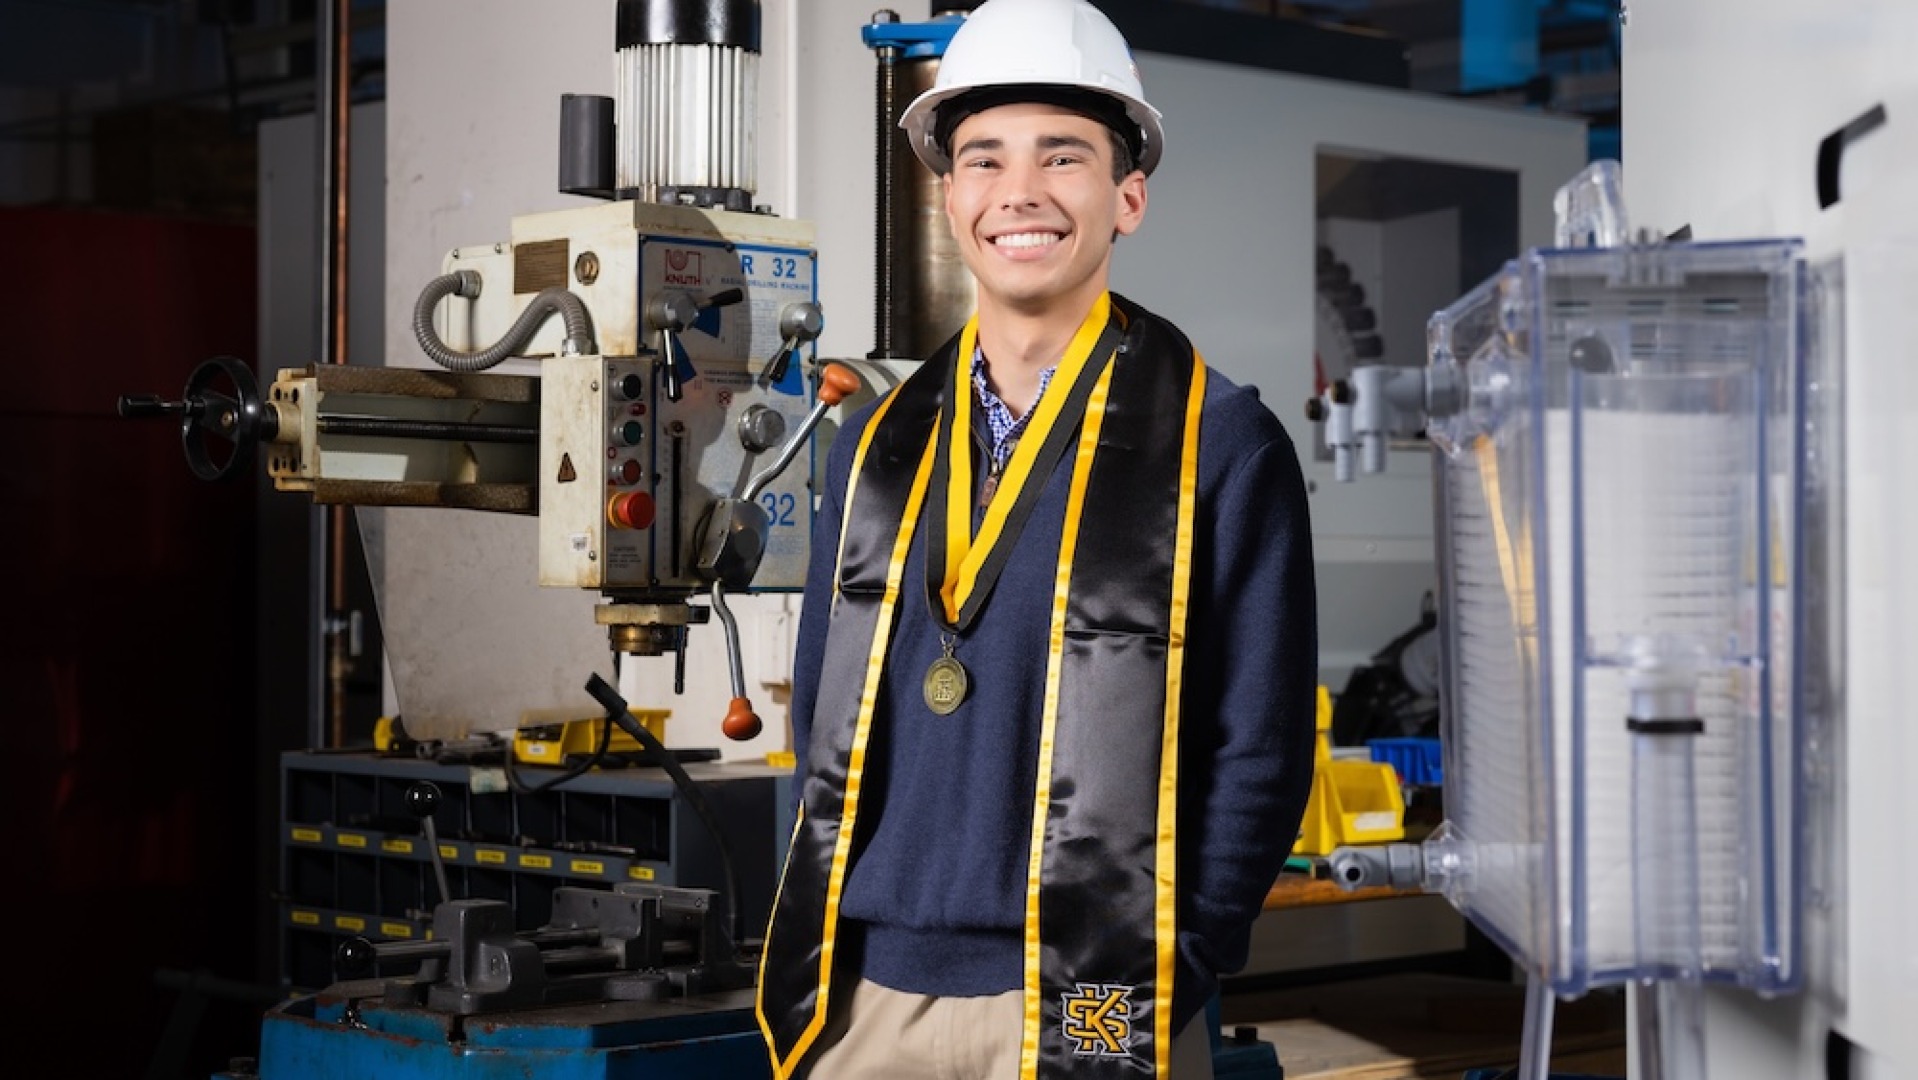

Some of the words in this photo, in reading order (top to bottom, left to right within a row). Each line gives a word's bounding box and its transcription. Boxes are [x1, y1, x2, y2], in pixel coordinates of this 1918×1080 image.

[772, 258, 797, 279] 32
[665, 274, 702, 286] KNUTH
[760, 492, 796, 527] 32
